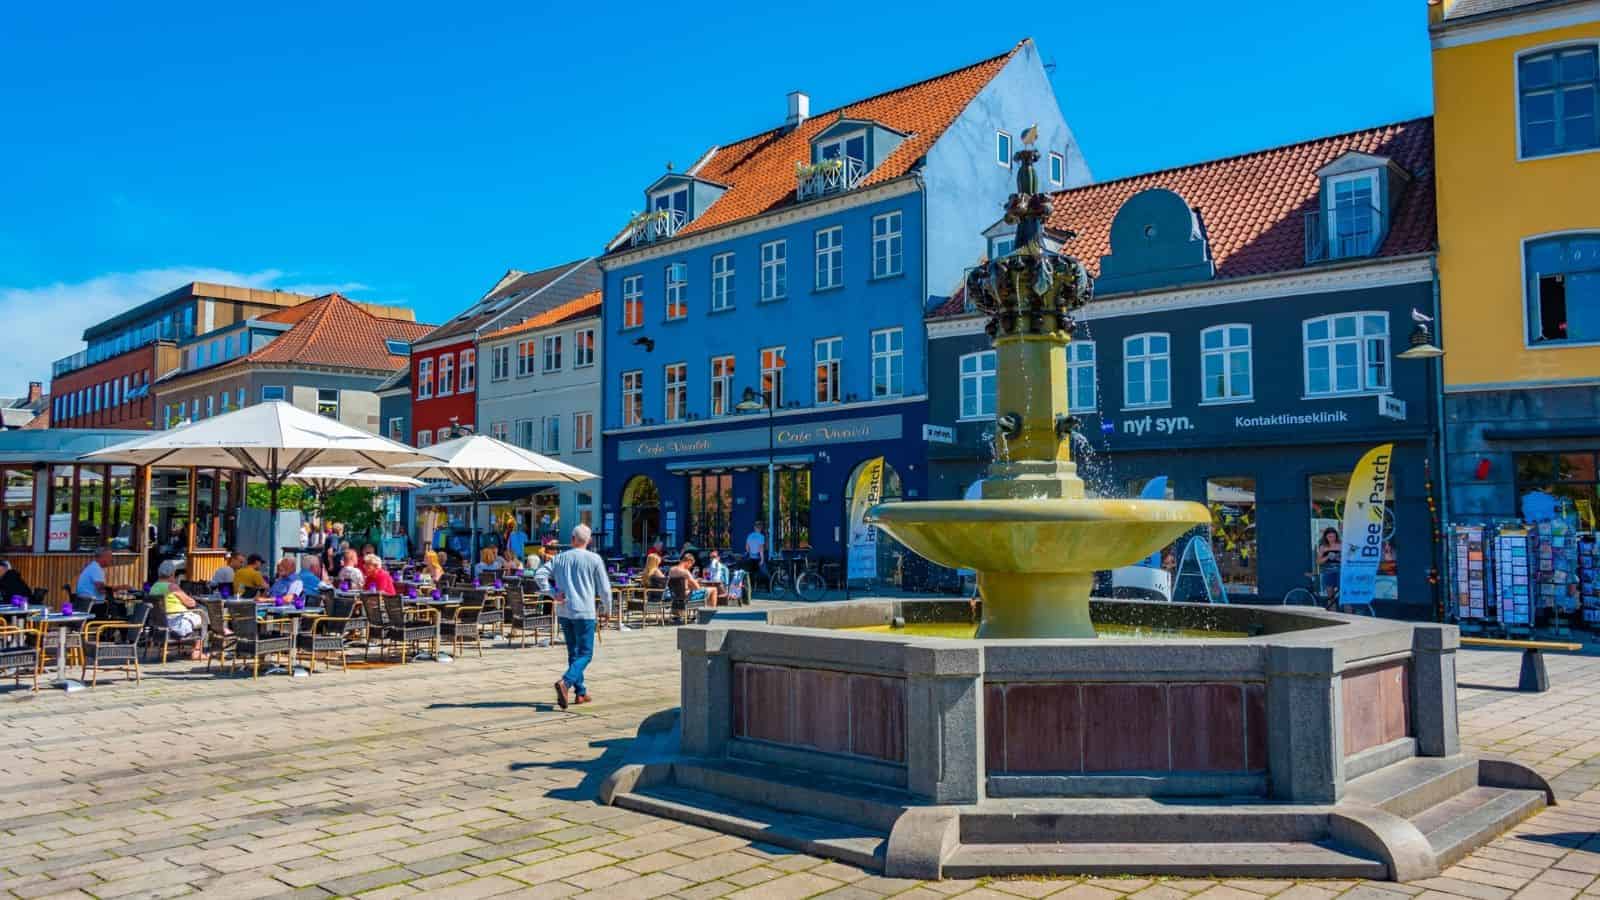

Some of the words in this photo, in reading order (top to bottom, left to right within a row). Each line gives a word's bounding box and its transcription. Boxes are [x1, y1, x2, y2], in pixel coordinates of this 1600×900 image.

[1123, 415, 1153, 436] nyt
[1156, 416, 1195, 434] syn.
[1235, 409, 1349, 428] Kontaktlinseklinik
[1370, 455, 1389, 504] Patch
[1362, 523, 1381, 558] Bee
